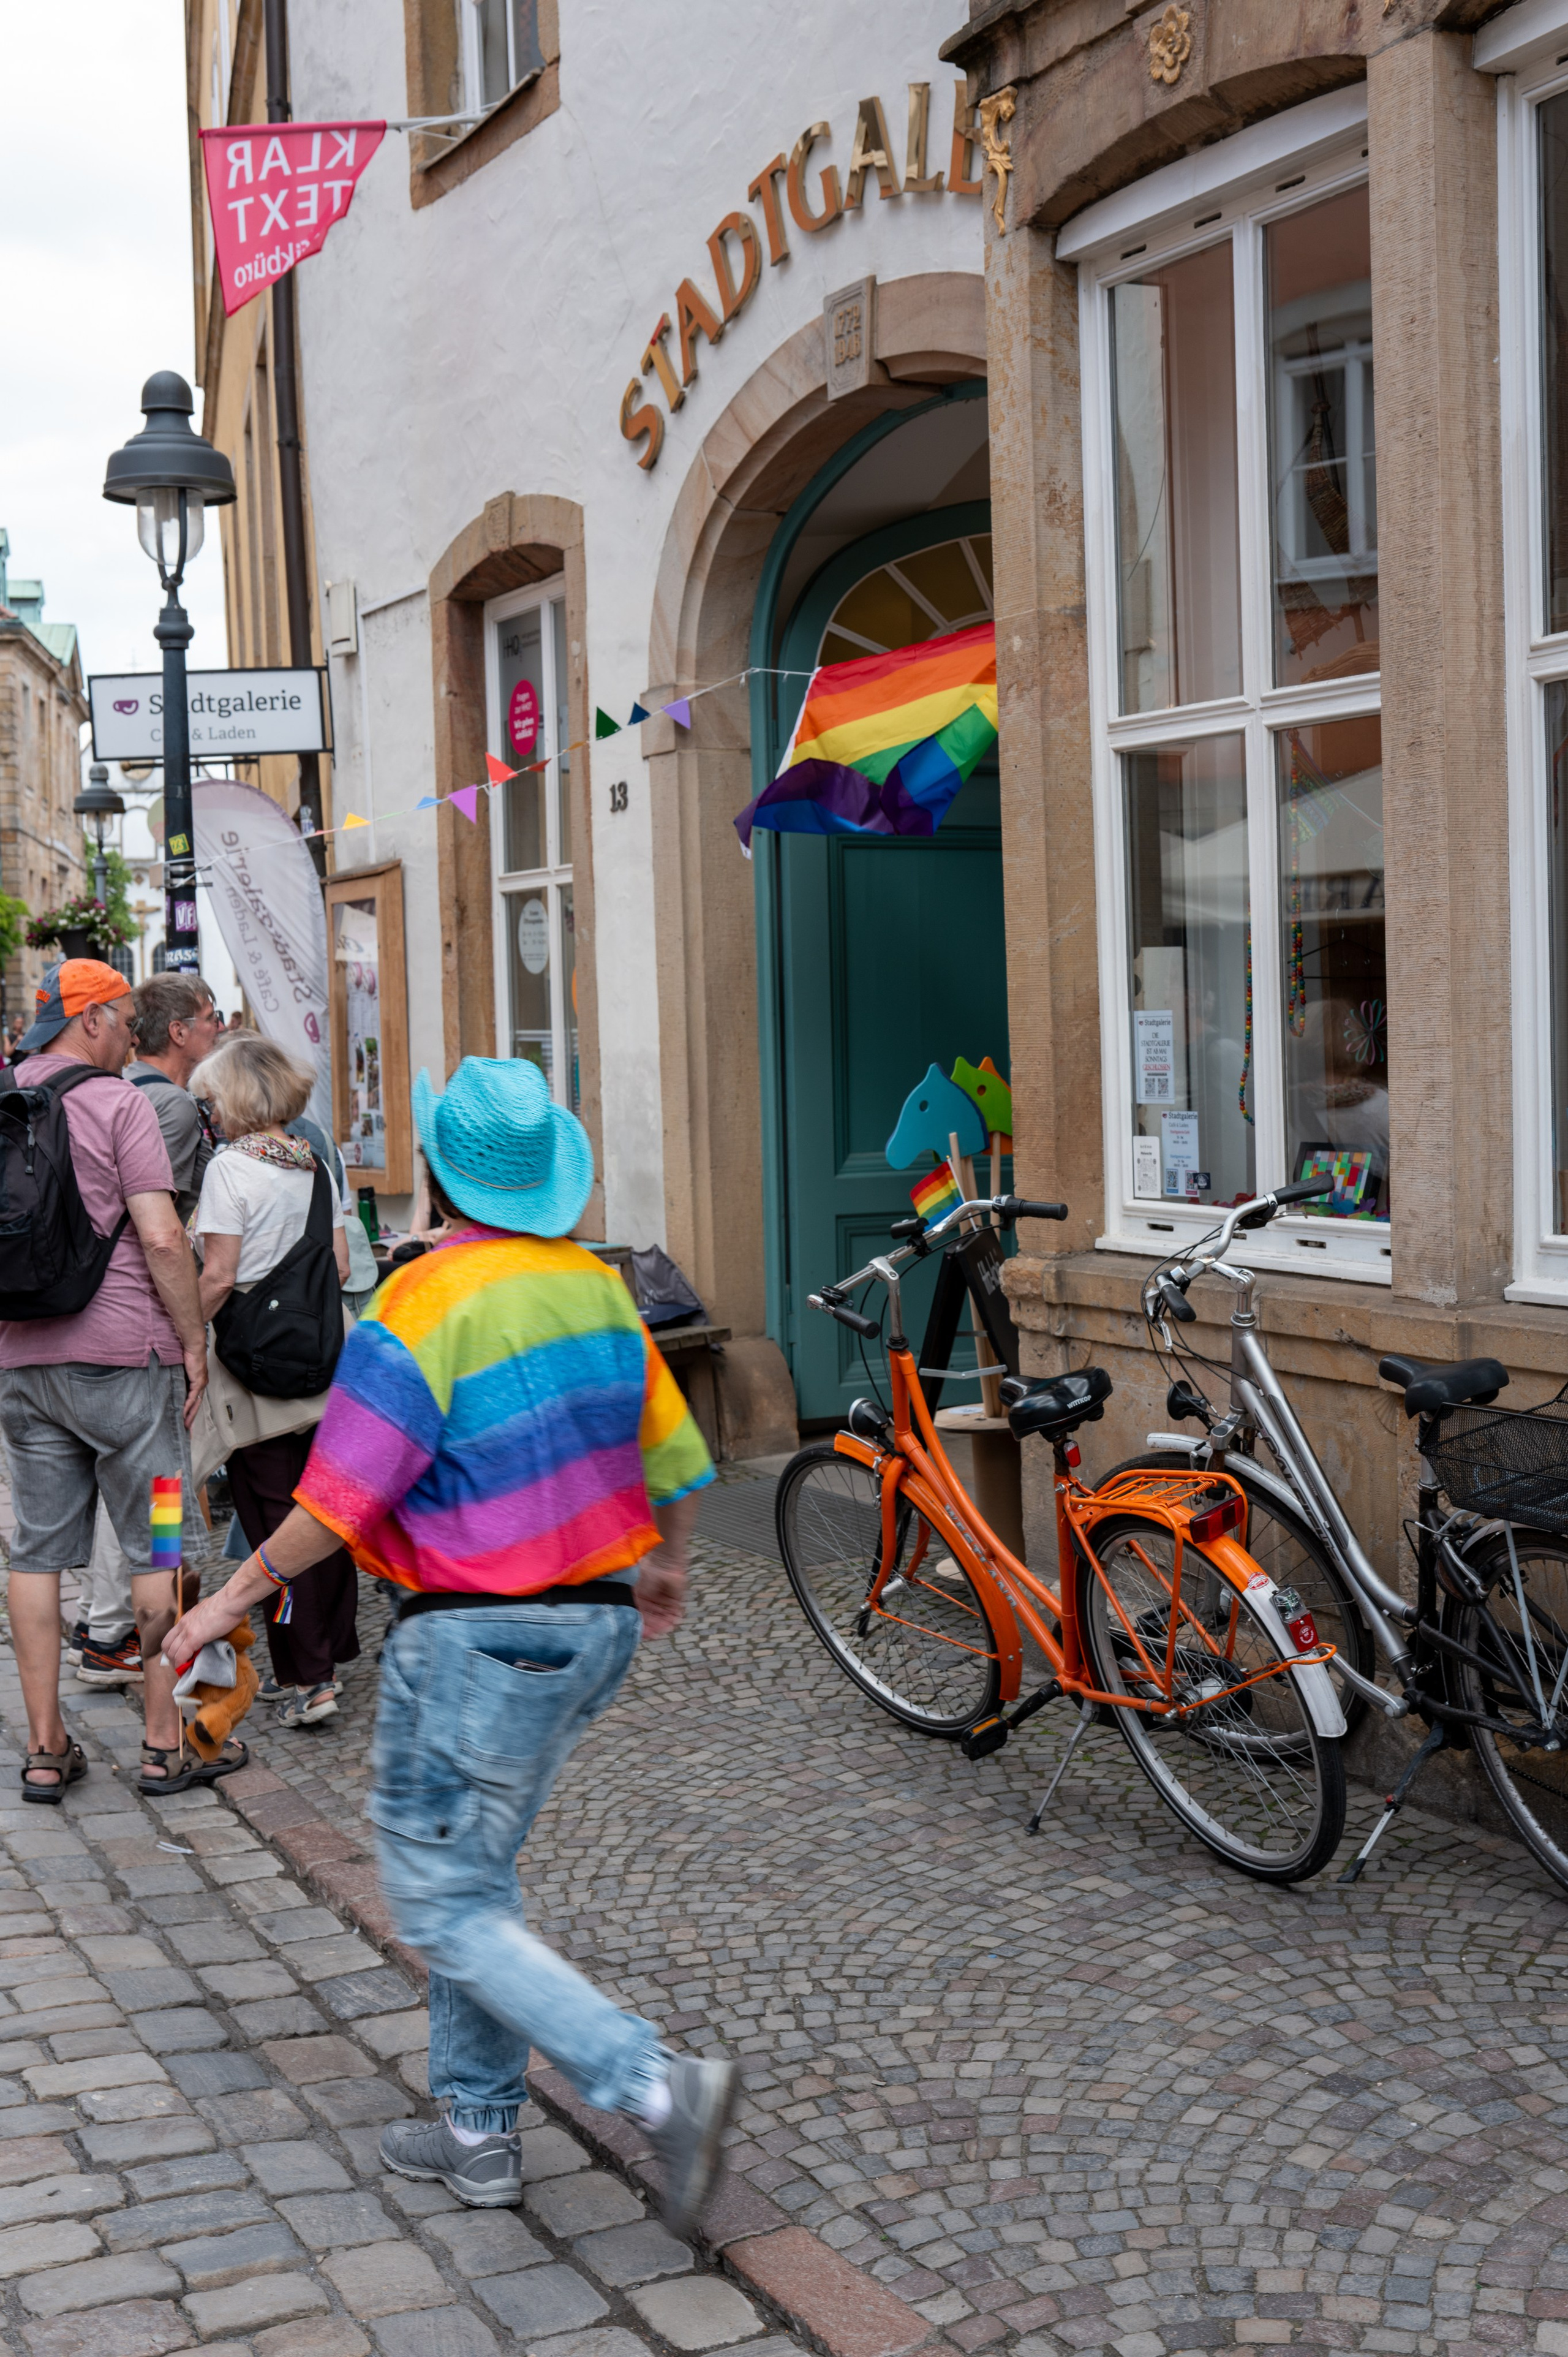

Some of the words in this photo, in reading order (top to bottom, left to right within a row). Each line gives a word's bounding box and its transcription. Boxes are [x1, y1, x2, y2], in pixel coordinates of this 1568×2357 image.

[149, 689, 302, 718] Sdtgalerie
[208, 725, 256, 741] Laden
[609, 781, 628, 813] 13
[1144, 1019, 1171, 1027] Stadtgalerie
[1168, 1112, 1198, 1121] Stadtgalerie
[1066, 1394, 1091, 1409] WITTKOP
